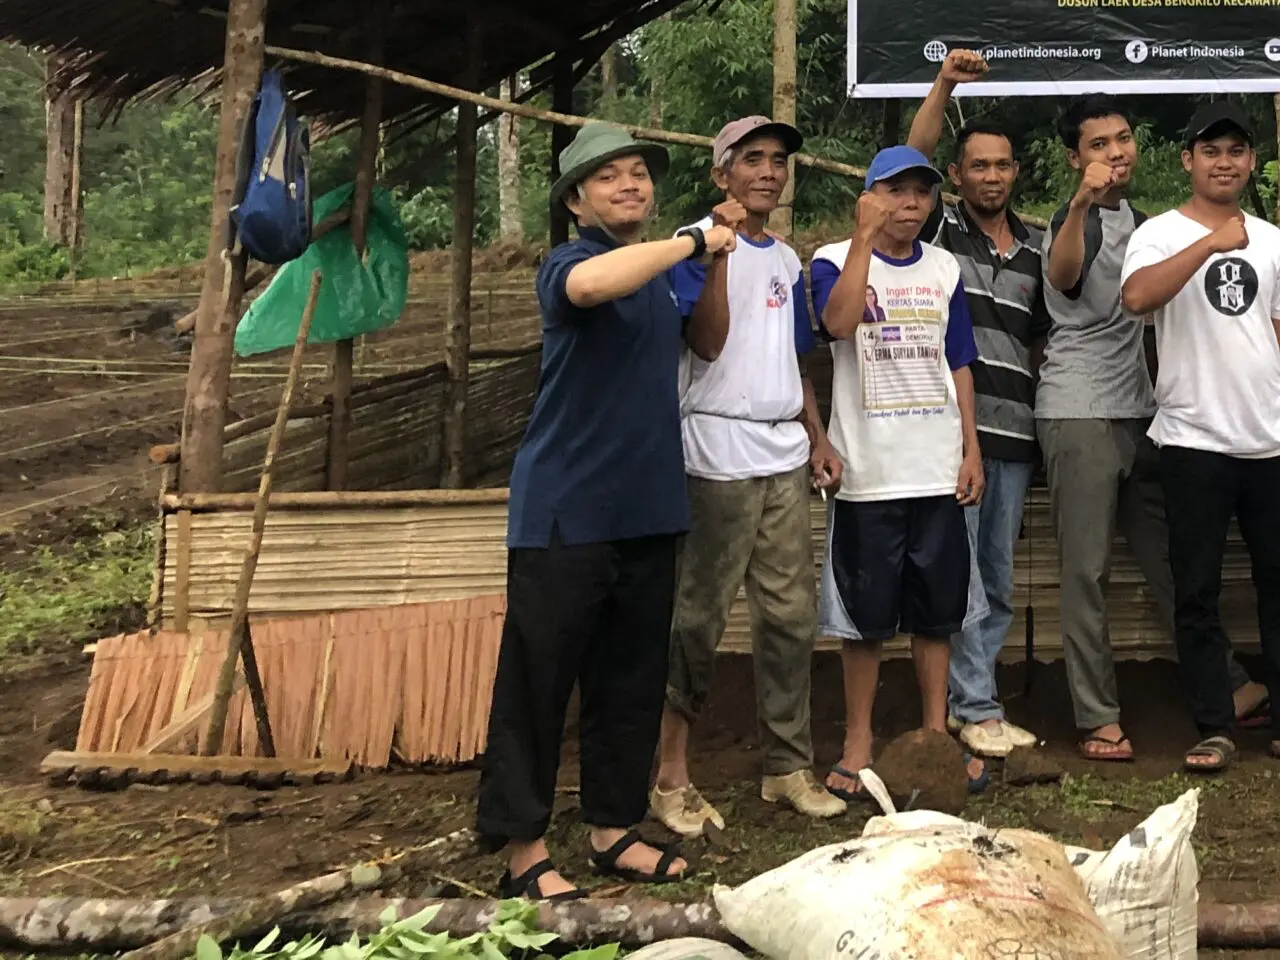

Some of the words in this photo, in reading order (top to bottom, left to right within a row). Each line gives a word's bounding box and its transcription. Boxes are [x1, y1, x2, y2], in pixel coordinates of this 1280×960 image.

[971, 46, 1101, 60] w.planetindonesia.org
[1152, 45, 1187, 57] Planet
[1190, 45, 1244, 57] Indonesia
[886, 287, 912, 298] Ingat!
